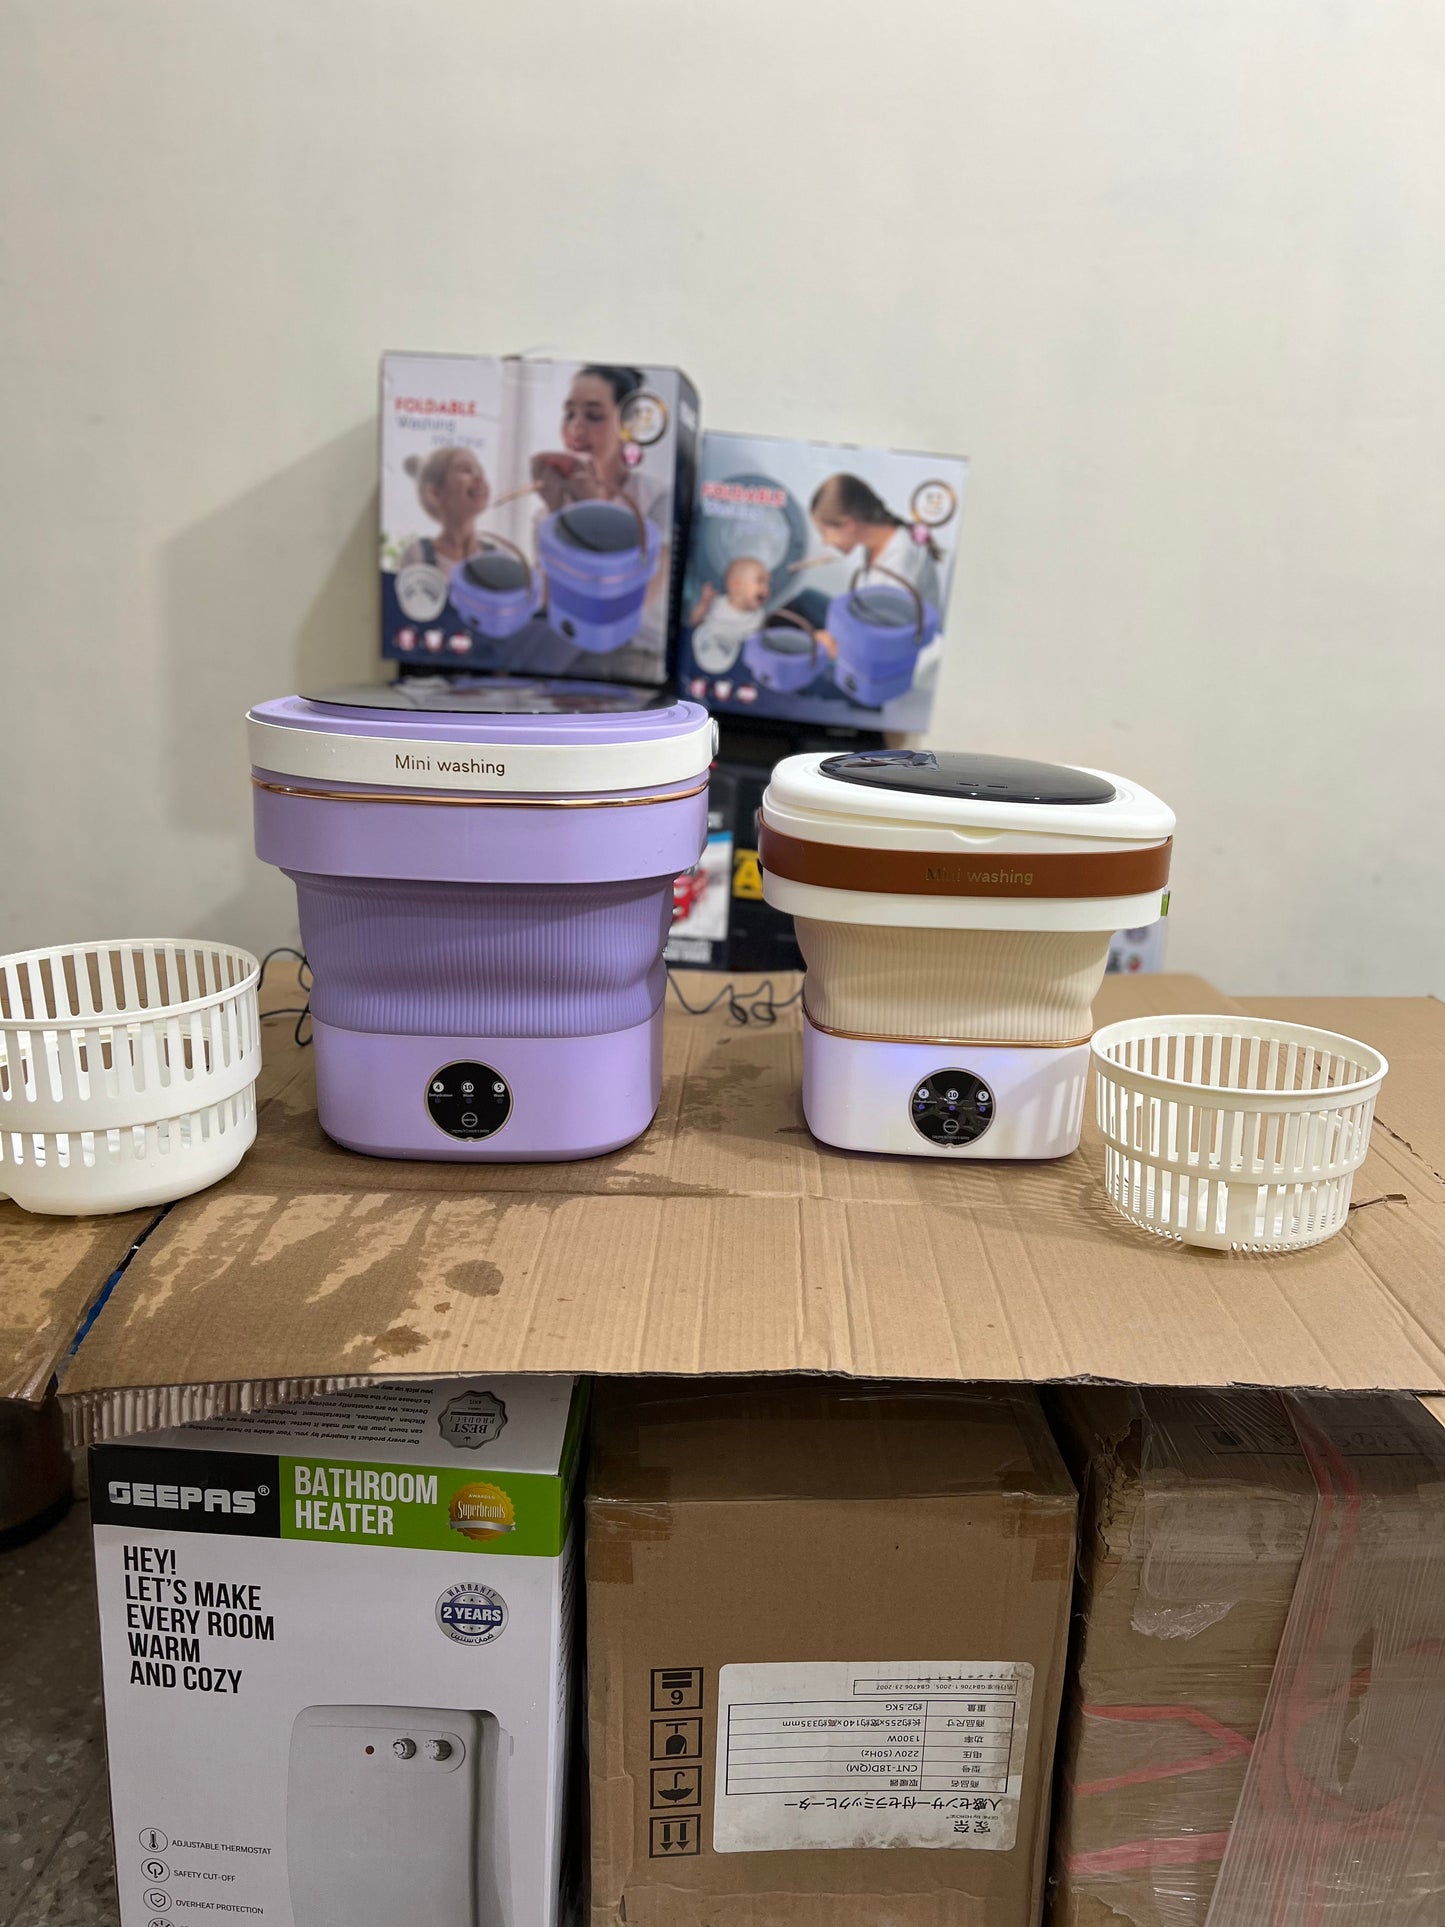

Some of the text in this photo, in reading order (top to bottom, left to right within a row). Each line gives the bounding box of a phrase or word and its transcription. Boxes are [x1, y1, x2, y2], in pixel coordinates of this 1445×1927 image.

[395, 754, 505, 777] Mini washing
[925, 867, 1033, 885] Mini washing
[302, 1411, 351, 1419] Entertainment
[451, 1423, 488, 1434] BEST
[294, 1465, 438, 1505] BATHROOM
[295, 1499, 394, 1536] HEATER
[457, 1500, 505, 1519] Superbrands
[123, 1545, 176, 1575] HEY!
[124, 1574, 262, 1611] LET’S MAKE
[446, 1583, 497, 1599] WARRANTY
[126, 1603, 275, 1641] EVERY ROOM
[443, 1606, 502, 1622] 2 YEARS
[450, 1631, 495, 1644] ضمان سنتين
[127, 1631, 200, 1663] WARM
[130, 1660, 243, 1694] AND COZY
[946, 1719, 985, 1728] 商品尺寸
[964, 1735, 983, 1743] 功率
[861, 1749, 893, 1758] (50Hz)
[962, 1750, 982, 1759] 电压
[846, 1763, 918, 1773] CNT-18D(QM)
[962, 1765, 981, 1773] 型号
[951, 1780, 980, 1788] 商品名
[784, 1796, 1003, 1811] 人感センサー付セラミックヒーター
[172, 1839, 272, 1855] ADJUSTABLE THERMOSTAT
[173, 1869, 236, 1882] SAFETY CUT-OFF
[175, 1899, 264, 1915] OVERHEAT PROTECTION
